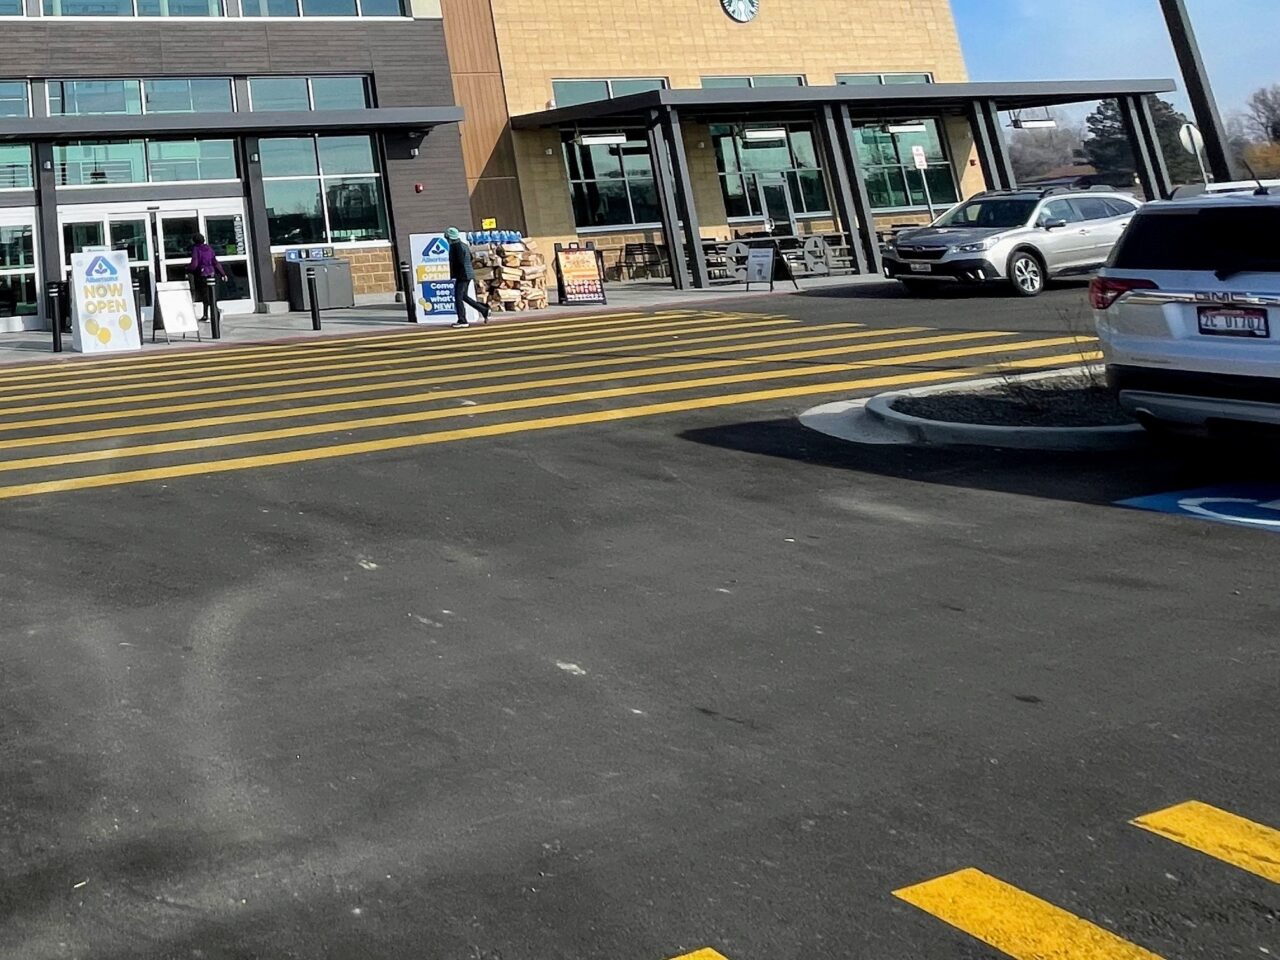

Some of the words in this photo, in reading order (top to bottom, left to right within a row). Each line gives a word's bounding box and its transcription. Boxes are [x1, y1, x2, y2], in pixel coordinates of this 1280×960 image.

[424, 264, 448, 272] GRAN
[83, 283, 123, 299] NOW
[1195, 292, 1246, 302] GMC
[85, 298, 128, 314] OPEN
